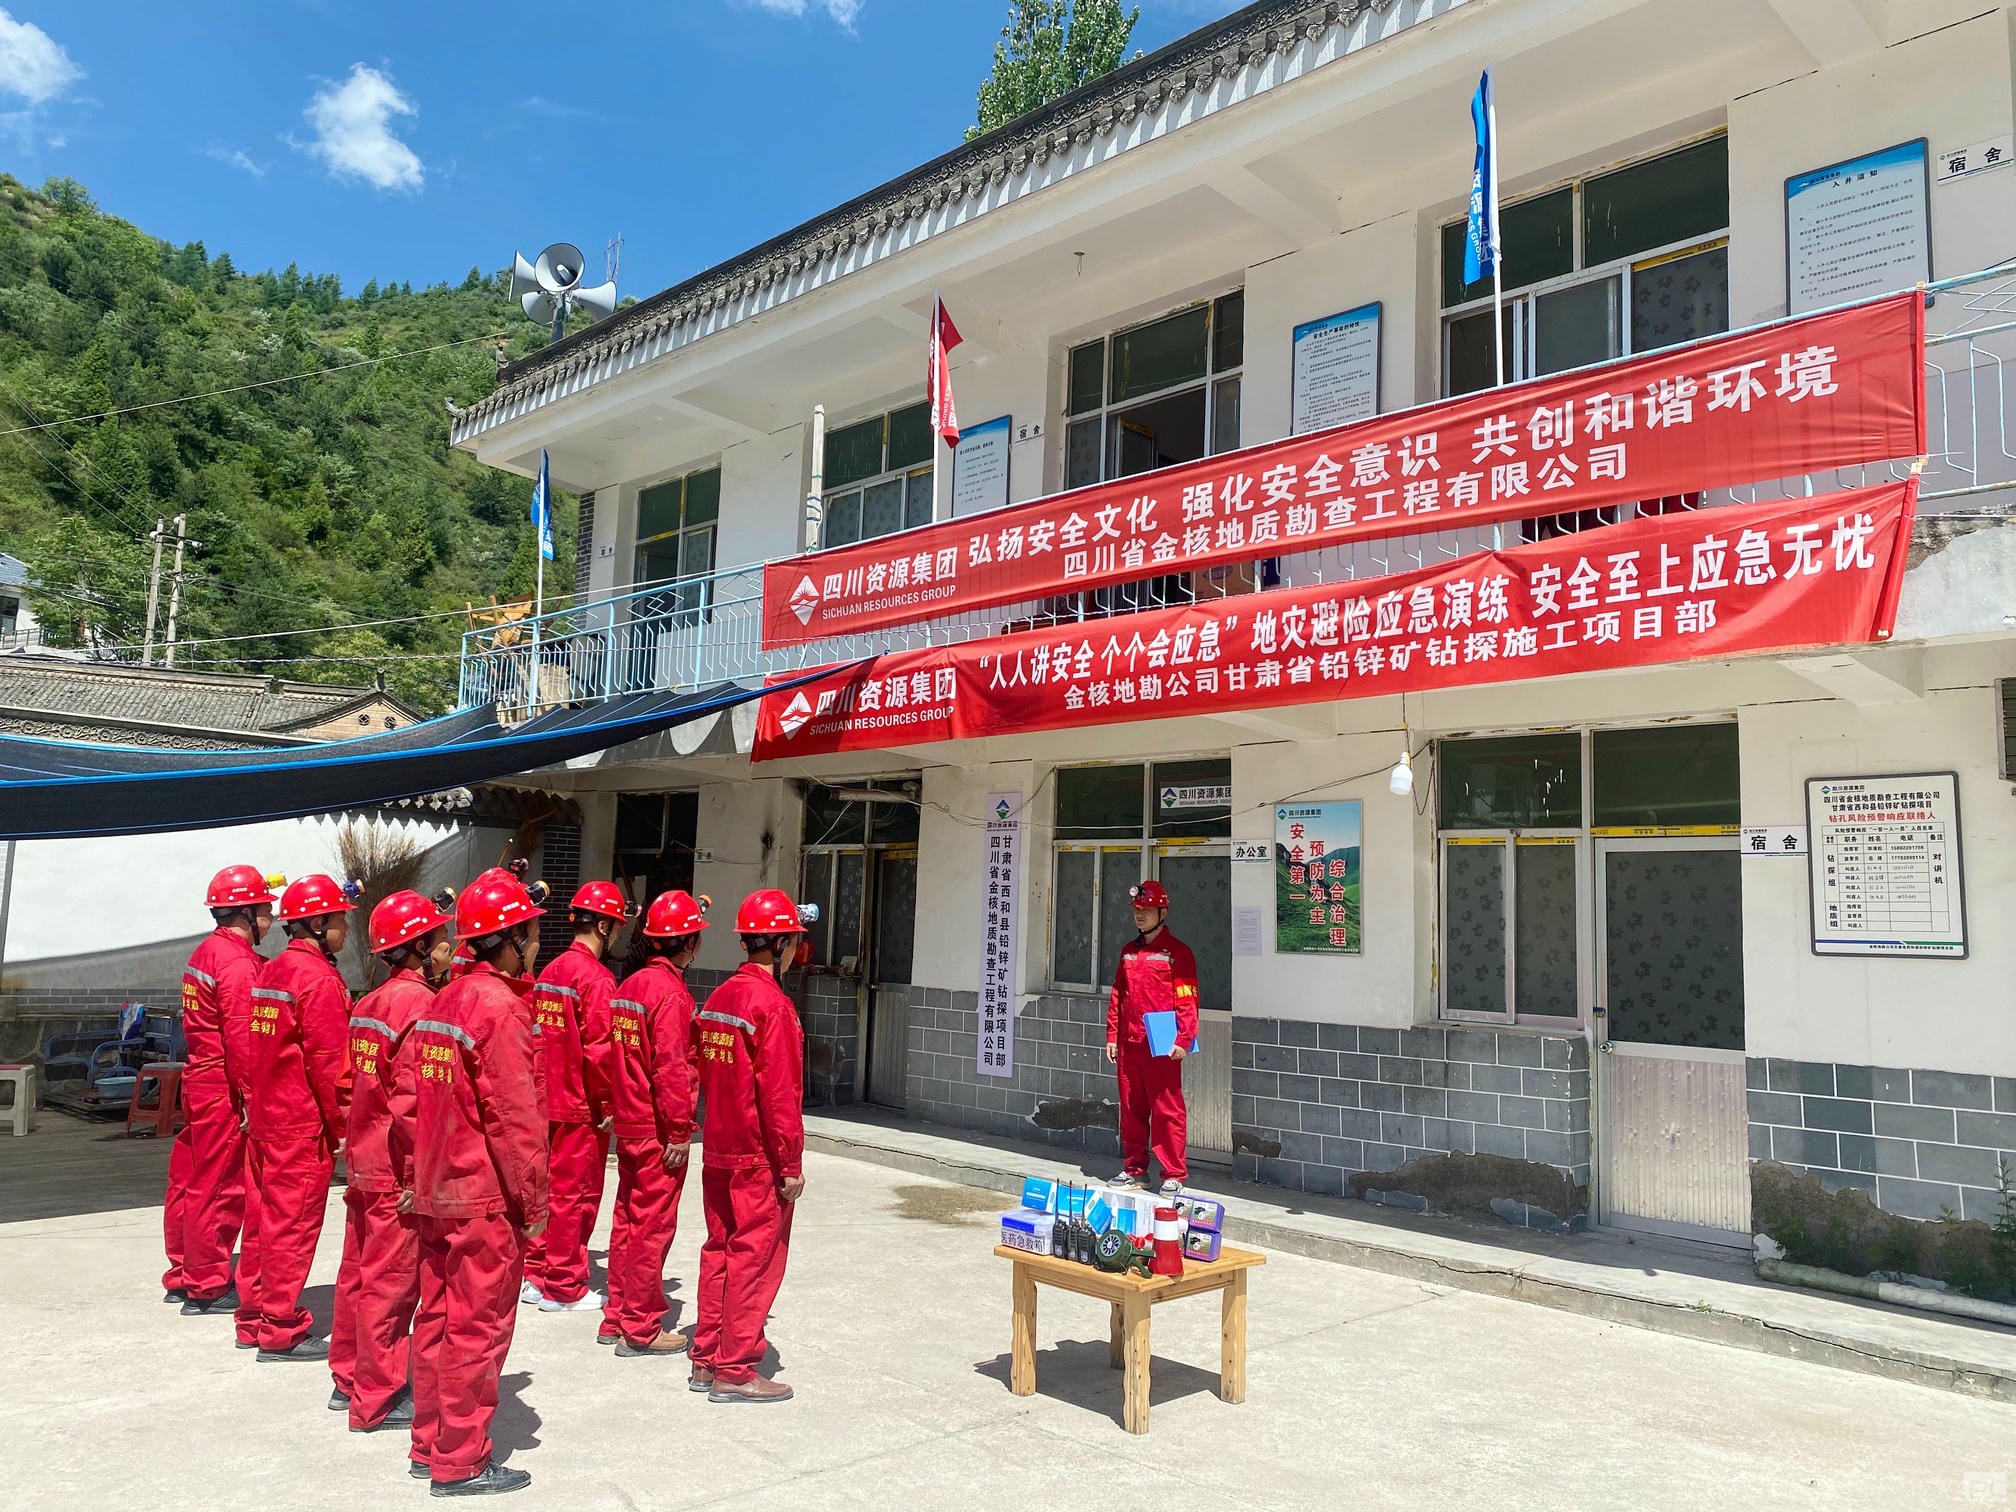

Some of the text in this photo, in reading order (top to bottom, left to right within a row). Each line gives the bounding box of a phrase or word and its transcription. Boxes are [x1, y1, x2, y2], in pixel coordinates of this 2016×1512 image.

[1949, 147, 2001, 173] 宿舍
[968, 495, 1158, 569] 弘扬安全文化
[1181, 430, 1440, 522] 强化安全意识
[1472, 344, 1839, 466] 共创和谐环境
[1063, 443, 1628, 579] 四川省金核地质勘查工程有限公司
[822, 546, 958, 600] 四川资源集团
[822, 585, 956, 620] SICHUAN RESOURCES GROUP
[1250, 575, 1509, 653] 地灾避险应急演练
[1530, 511, 1876, 617] 安全至上应急无忧
[815, 668, 957, 716] 四川资源集团
[1064, 599, 1716, 710] 金核地勘公司甘肃省铅锌矿钻探施工项目部
[809, 705, 955, 736] SICHUAN RESOURCES GROUP
[1235, 846, 1268, 858] 办公室
[1751, 834, 1798, 850] 宿舍
[1829, 811, 1936, 823] 钻孔风险预警响应联络人
[1290, 823, 1305, 900] 安全第一
[1309, 840, 1325, 924] 预防为主
[1329, 859, 1346, 946] 综合治理
[984, 836, 1001, 1066] 四川省金核地质勘查工程有限公司
[995, 835, 1013, 1068] 甘肃省西和县铅锌矿钻探项目部
